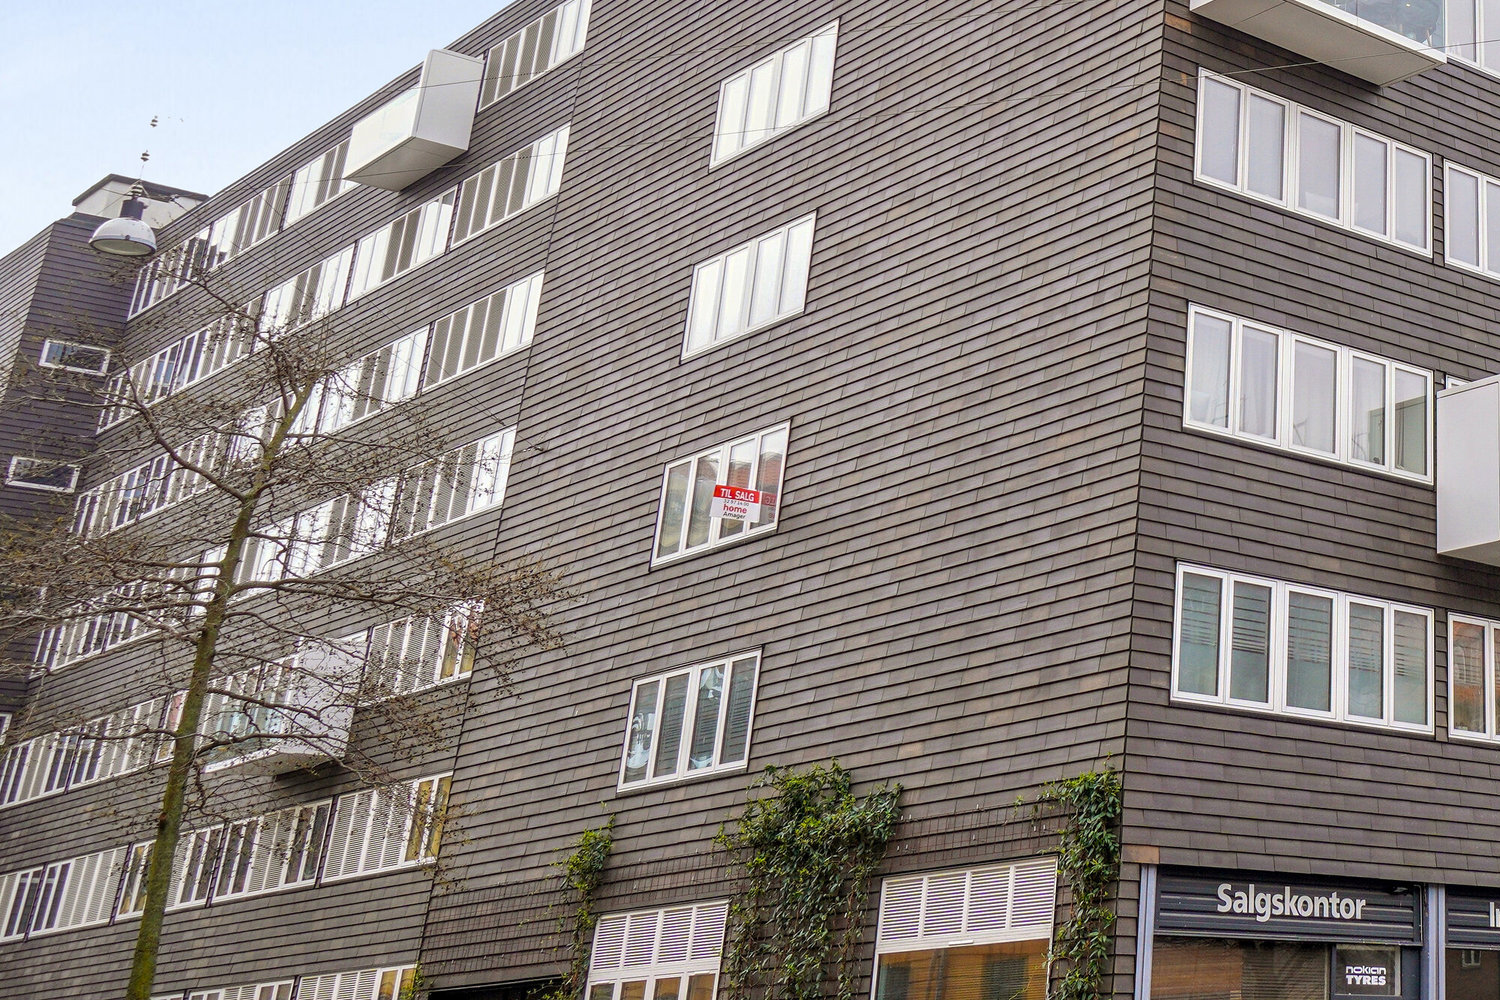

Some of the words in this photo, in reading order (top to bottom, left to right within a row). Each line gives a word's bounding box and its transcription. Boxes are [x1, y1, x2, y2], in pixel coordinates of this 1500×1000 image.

[721, 488, 732, 498] TIL
[735, 491, 754, 501] SALG
[723, 503, 747, 514] home
[723, 511, 746, 519] Amager
[1217, 883, 1366, 922] Salgskontor
[1345, 965, 1387, 975] nokian
[1345, 974, 1387, 986] TYRES
